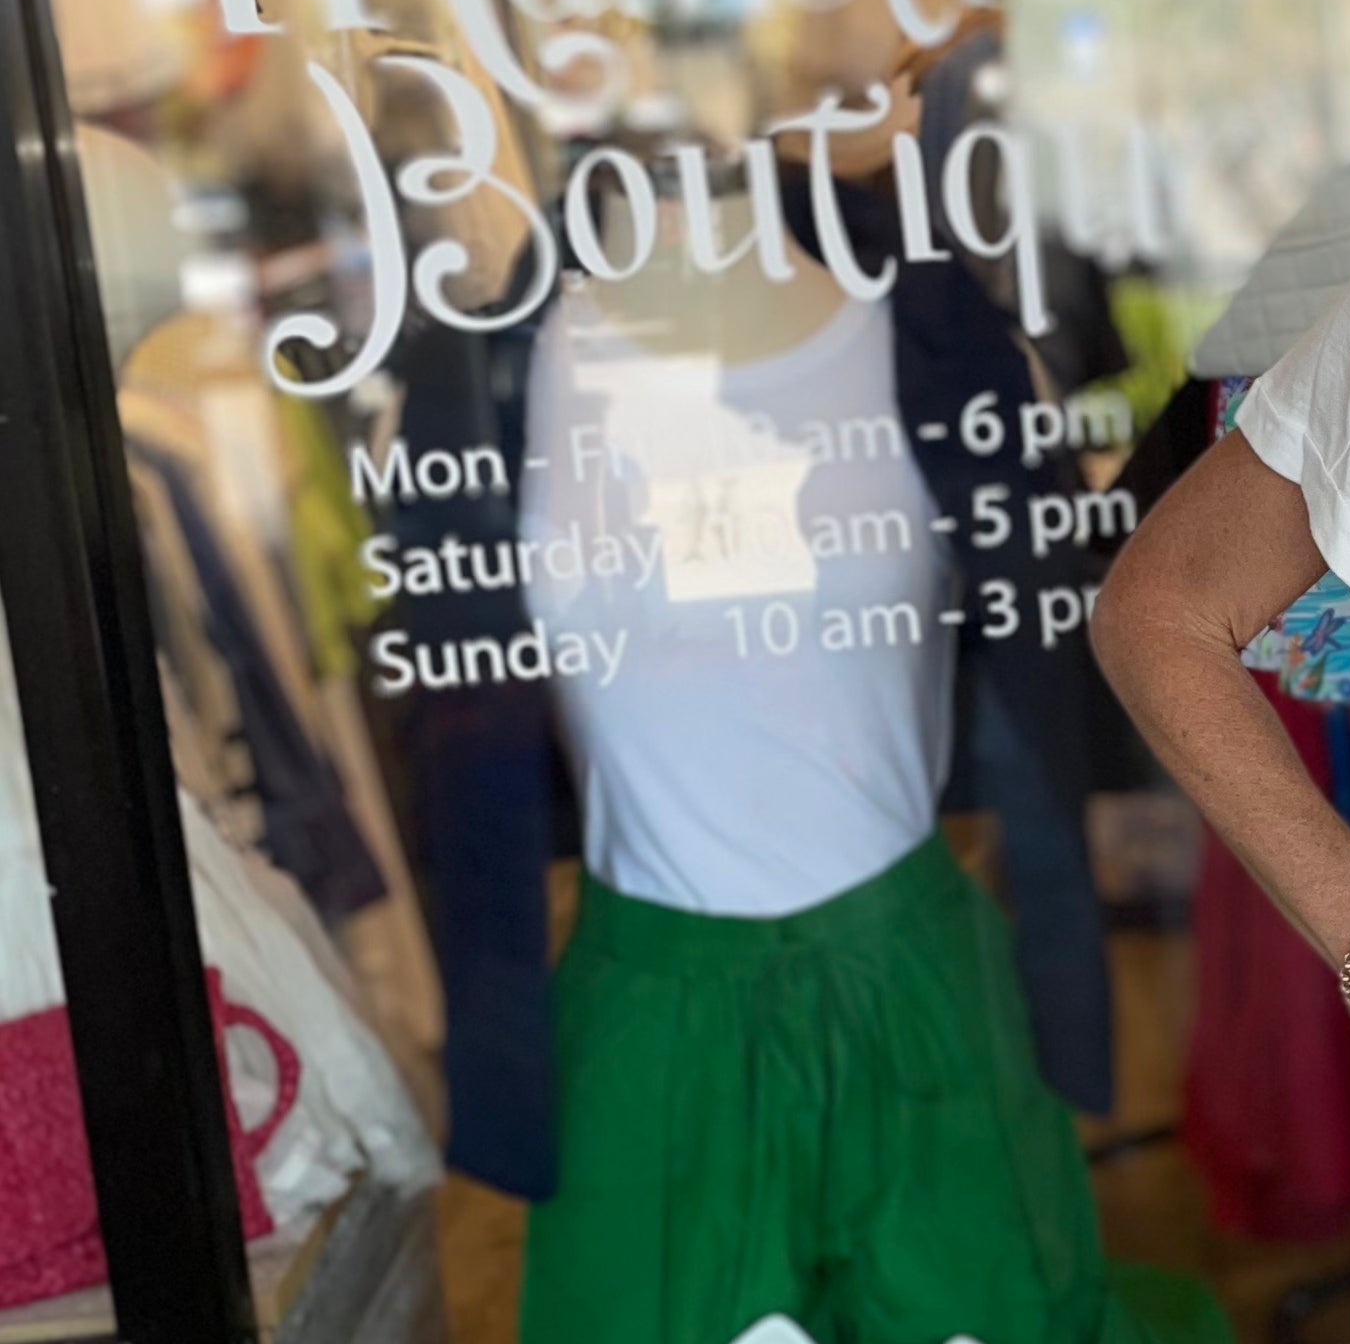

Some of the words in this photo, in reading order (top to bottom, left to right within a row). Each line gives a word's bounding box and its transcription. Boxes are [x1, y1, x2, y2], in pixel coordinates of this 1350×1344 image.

[350, 435, 510, 503] Mon
[801, 413, 898, 458] am
[960, 391, 1004, 454] 6
[1018, 393, 1132, 468] pm
[360, 520, 662, 601] Saturday
[812, 507, 911, 557] am
[971, 483, 1013, 549] 5
[1028, 487, 1138, 557] pm
[371, 618, 630, 697] Sunday
[724, 600, 798, 658] 10
[820, 601, 922, 652] am
[979, 578, 1020, 640] 3
